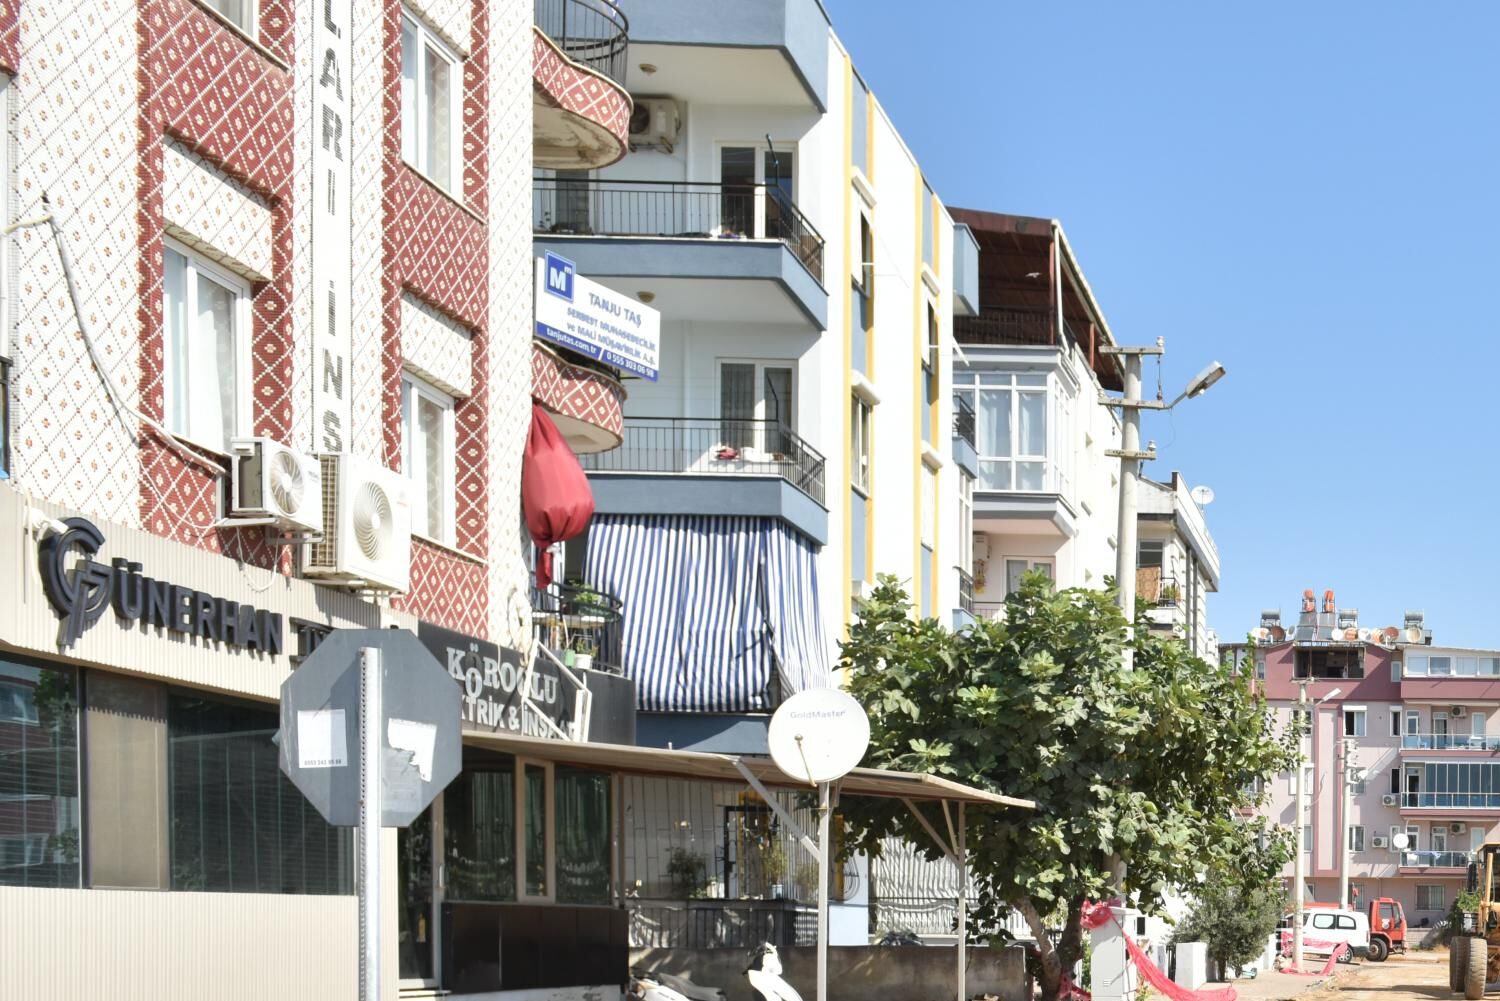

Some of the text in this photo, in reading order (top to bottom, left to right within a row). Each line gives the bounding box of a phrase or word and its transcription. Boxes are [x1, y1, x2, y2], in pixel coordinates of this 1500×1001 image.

[589, 293, 642, 328] TANJU TAŞ
[546, 327, 597, 354] tanjutas.com.tr
[508, 706, 520, 731] &
[790, 710, 845, 719] GoldMaster
